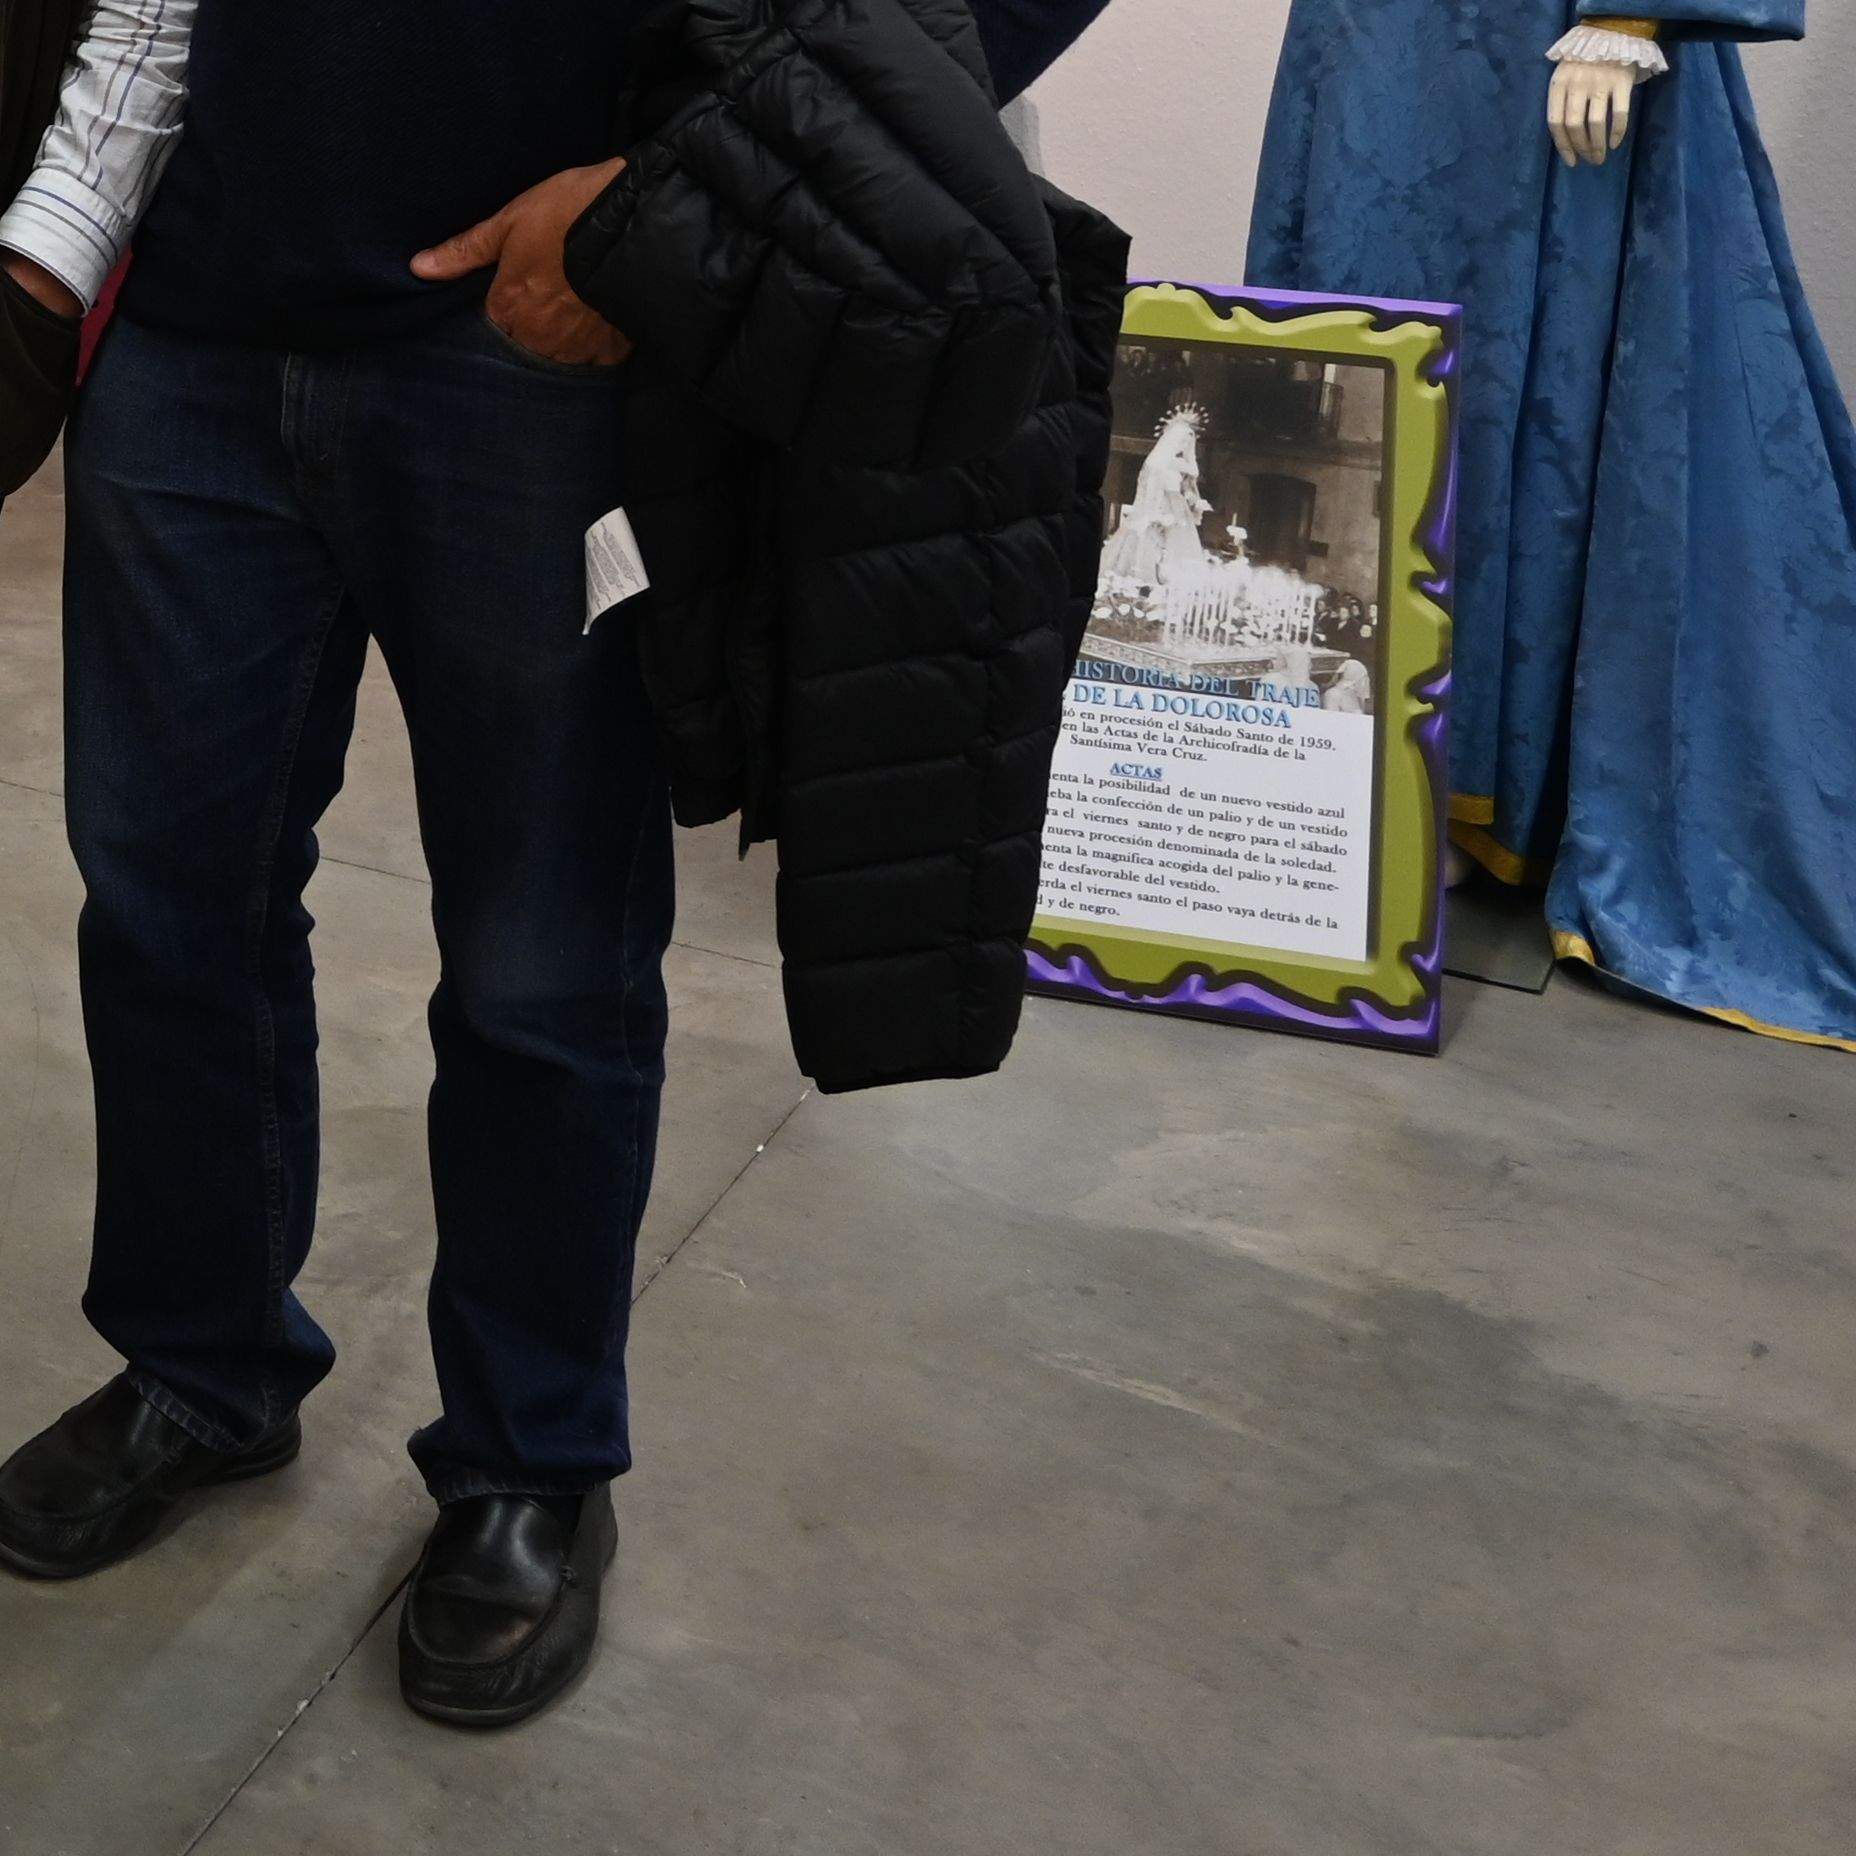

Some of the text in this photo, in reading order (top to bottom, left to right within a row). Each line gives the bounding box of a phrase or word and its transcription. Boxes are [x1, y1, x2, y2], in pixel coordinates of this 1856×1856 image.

[1073, 684, 1291, 729] DE LA DOLOROSA
[1189, 672, 1240, 696] DEL
[1245, 679, 1321, 708] TRAJE
[1062, 721, 1306, 761] en las Actas de la Archicofradía de la
[1070, 733, 1208, 762] Santísima Vera Cruz.
[1080, 711, 1095, 720] en
[1100, 713, 1163, 729] procesión
[1168, 720, 1179, 731] el
[1183, 721, 1232, 737] Sábado
[1236, 728, 1274, 743] Santo
[1278, 733, 1294, 746] de
[1300, 736, 1336, 751] 1959.
[1110, 763, 1162, 780] ACTAS
[1048, 788, 1348, 838] eba la confección de un palio y de un vestido
[1049, 773, 1345, 819] enta la posibilidad de un nuevo vestido azul
[1047, 825, 1337, 873] nueva procesión denominada de la soledad.
[1063, 808, 1074, 819] el
[1083, 811, 1129, 826] viernes
[1138, 819, 1172, 832] santo
[1176, 827, 1184, 835] y
[1188, 825, 1204, 836] de
[1208, 830, 1246, 842] negro
[1250, 835, 1279, 847] para
[1284, 838, 1296, 849] el
[1300, 840, 1348, 856] sábado
[1043, 844, 1072, 854] enta
[1076, 845, 1088, 856] la
[1158, 858, 1208, 874] acogida
[1212, 864, 1233, 877] del
[1237, 869, 1271, 882] palio
[1275, 876, 1283, 885] y
[1287, 874, 1298, 886] la
[1302, 879, 1339, 892] gene-
[1058, 861, 1140, 882] desfavorable
[1144, 874, 1165, 886] del
[1169, 878, 1220, 893] vestido.
[1048, 898, 1055, 908] y
[1058, 897, 1075, 909] de
[1079, 902, 1120, 916] negro.
[1070, 881, 1082, 892] el
[1086, 884, 1132, 899] viernes
[1137, 892, 1172, 905] santo
[1176, 897, 1188, 907] el
[1192, 900, 1223, 912] paso
[1227, 905, 1255, 918] vaya
[1259, 908, 1301, 923] detrás
[1305, 914, 1322, 927] de
[1326, 917, 1338, 929] la
